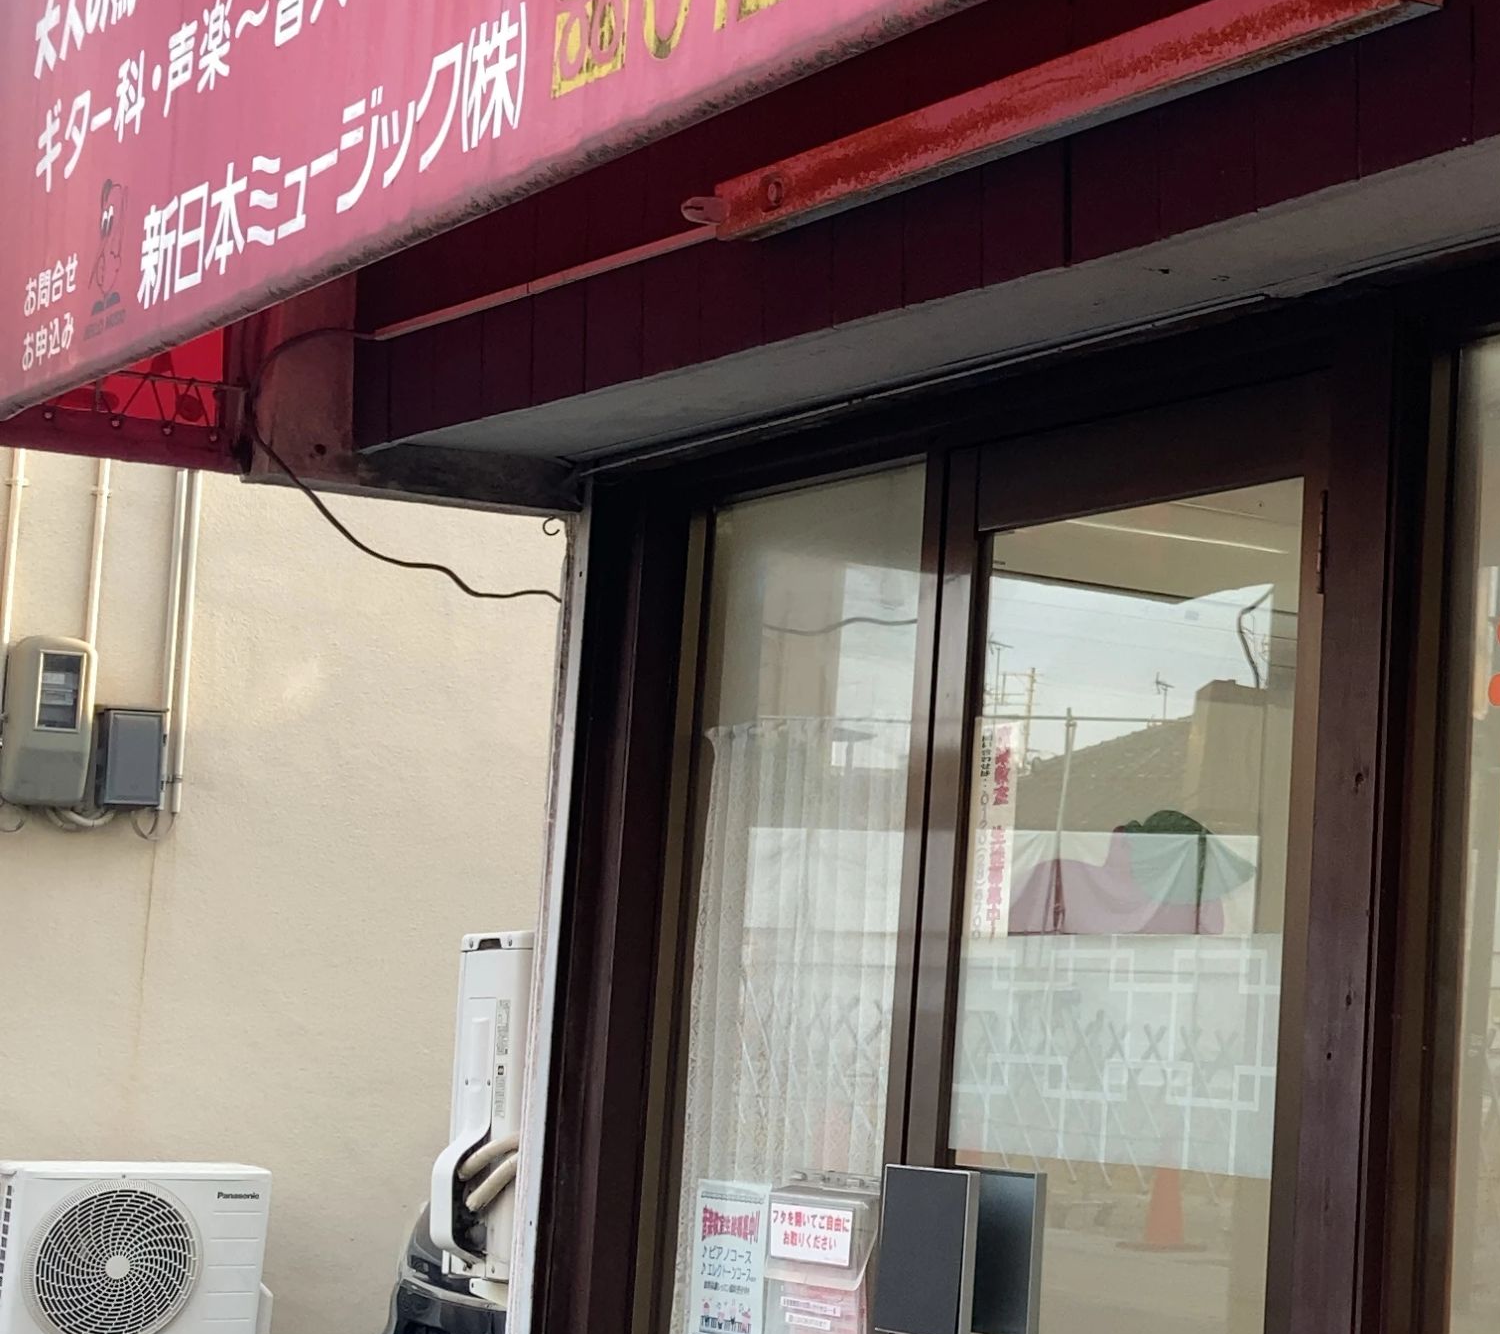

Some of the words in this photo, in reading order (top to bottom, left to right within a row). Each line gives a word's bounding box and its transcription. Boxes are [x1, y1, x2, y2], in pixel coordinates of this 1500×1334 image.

[24, 253, 78, 316] お問合せ
[22, 312, 74, 371] お申込み
[217, 1191, 260, 1200] Panasonic
